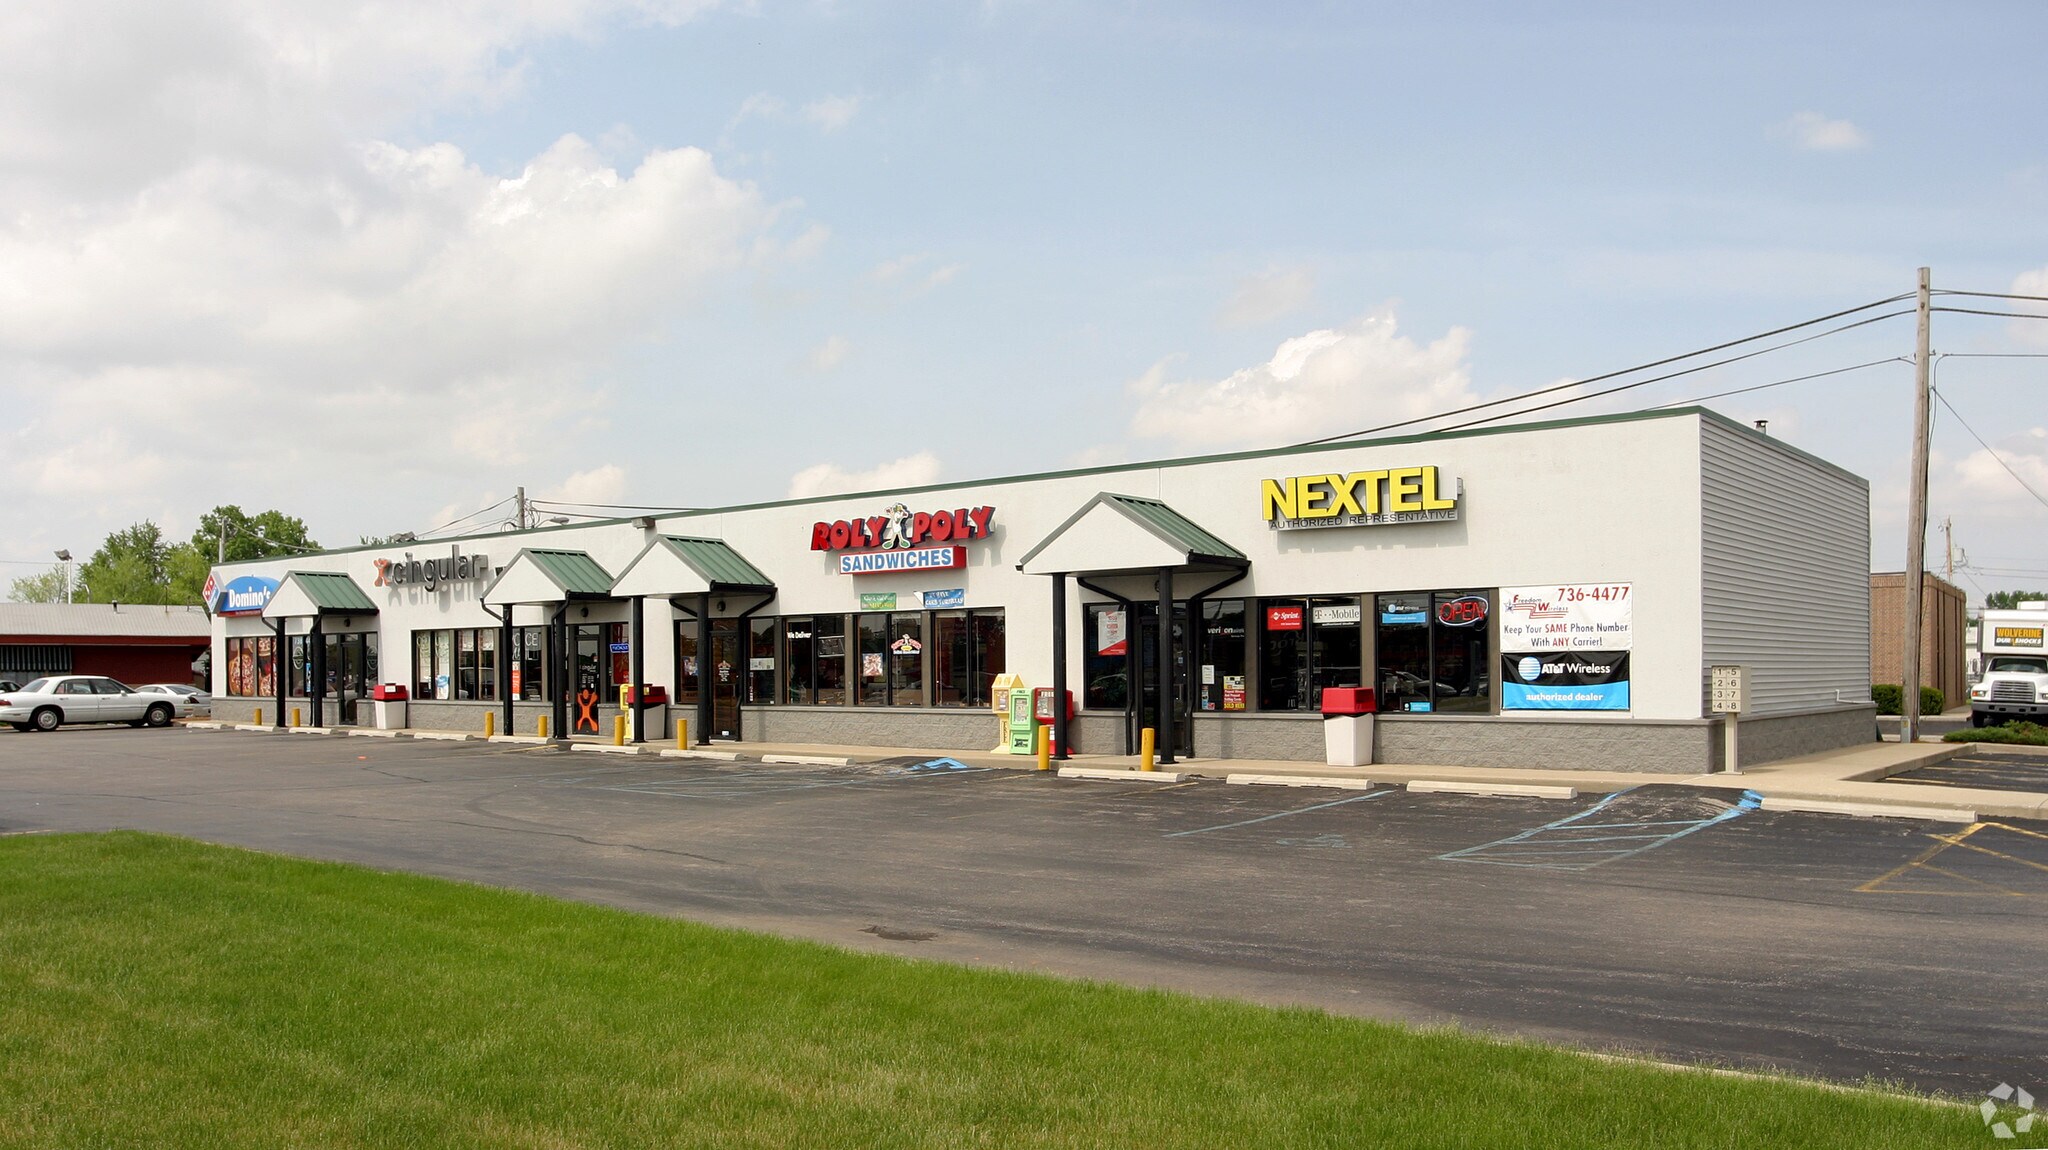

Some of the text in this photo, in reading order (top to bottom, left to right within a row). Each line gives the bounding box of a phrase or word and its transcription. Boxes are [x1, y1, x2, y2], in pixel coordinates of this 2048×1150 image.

[1261, 466, 1455, 521] NEXTEL
[1270, 511, 1456, 530] AUTHORIZED REPRESENTATIVE
[811, 506, 996, 551] ROLY POLY
[842, 549, 951, 572] SANDWICHES
[393, 545, 488, 592] cingular
[229, 586, 271, 608] Domino's
[1513, 594, 1542, 603] Freedom
[1558, 586, 1630, 602] 736-4477
[1440, 602, 1485, 621] OPEN
[1538, 602, 1569, 611] Wireless
[1280, 611, 1299, 620] Sprint
[1504, 621, 1628, 636] Keep Your SAME Phone Number
[1996, 628, 2042, 638] WOLVERINE
[1531, 637, 1603, 647] With ANY Carrier!
[1541, 662, 1611, 674] AT&T Wireless
[1731, 668, 1737, 676] 5
[1717, 679, 1737, 687] 2 6
[1526, 692, 1603, 701] authorized dealer
[1717, 690, 1736, 698] 3 7
[1730, 702, 1737, 710] 8
